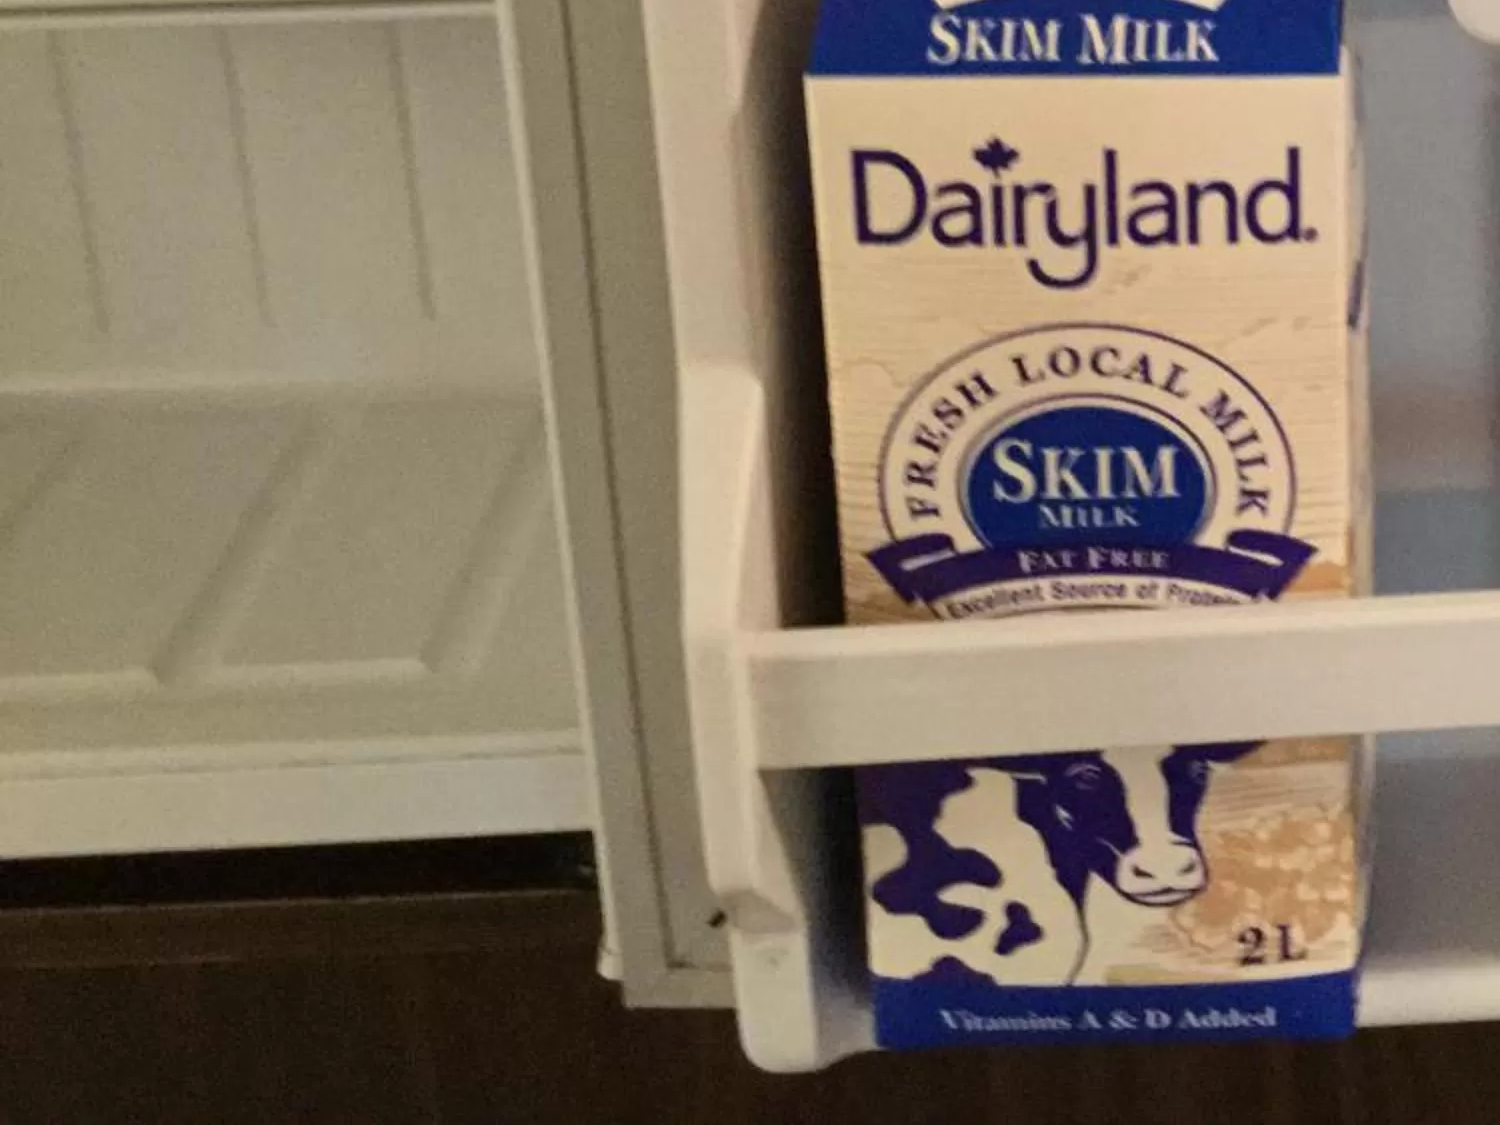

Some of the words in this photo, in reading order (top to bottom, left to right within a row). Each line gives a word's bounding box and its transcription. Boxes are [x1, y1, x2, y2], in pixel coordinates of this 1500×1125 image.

[926, 11, 1061, 65] SKIM
[1075, 13, 1220, 65] MILK
[850, 136, 1304, 289] Dairyland
[905, 374, 1000, 522] FRESH
[1013, 345, 1190, 401] LOCAL
[1199, 389, 1271, 518] MILK
[992, 436, 1181, 504] SKIM
[1038, 502, 1142, 530] MILK
[1017, 549, 1075, 575] FAT
[1086, 546, 1171, 572] FREE
[1050, 581, 1127, 601] Source
[938, 1009, 1073, 1033] Vitamins
[1079, 1009, 1103, 1032] A
[1108, 1009, 1138, 1032] &
[1144, 1008, 1171, 1030] D
[1179, 1005, 1278, 1030] Added
